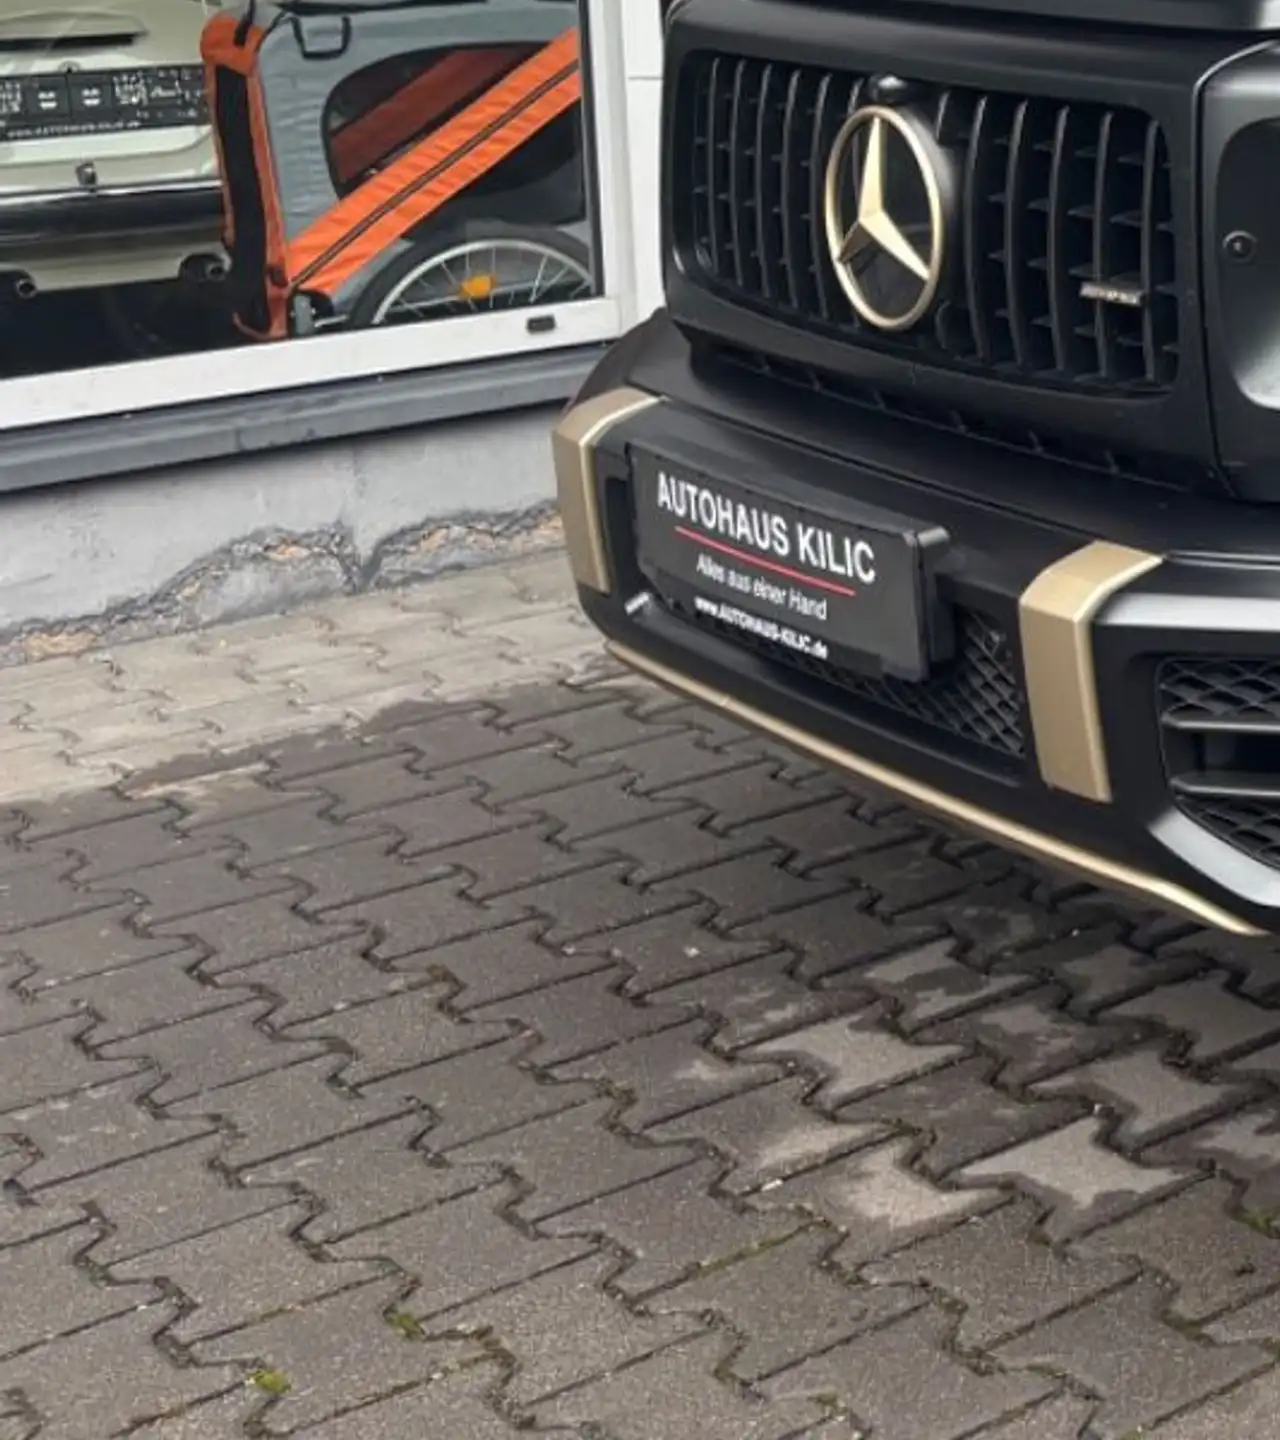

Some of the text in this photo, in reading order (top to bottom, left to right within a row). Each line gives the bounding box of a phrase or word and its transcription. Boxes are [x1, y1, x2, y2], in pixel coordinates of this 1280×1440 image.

[657, 471, 876, 584] AUTOHAUS KILIC
[696, 553, 827, 620] Alles aus einer Hand
